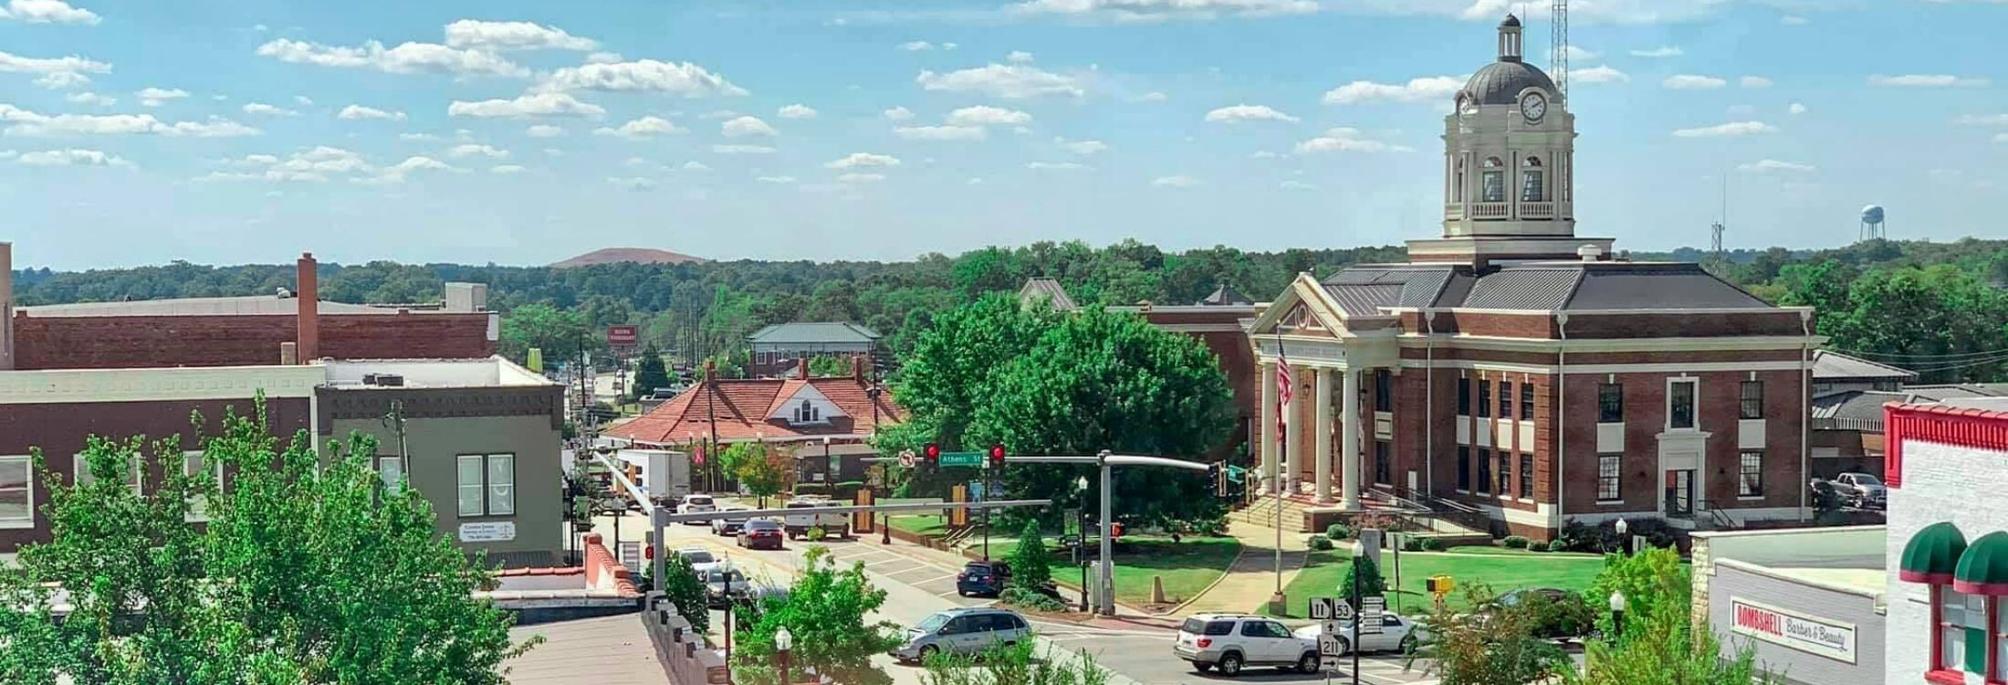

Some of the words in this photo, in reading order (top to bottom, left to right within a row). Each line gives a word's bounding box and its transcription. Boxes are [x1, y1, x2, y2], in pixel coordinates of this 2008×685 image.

[943, 455, 967, 463] Athens
[974, 455, 981, 463] St
[1315, 603, 1324, 616] 11
[1336, 604, 1349, 617] 53
[1737, 605, 1783, 636] BOMBSHELL
[1785, 618, 1812, 638] Barber
[1819, 626, 1845, 647] Beauty
[1323, 641, 1338, 653] 211
